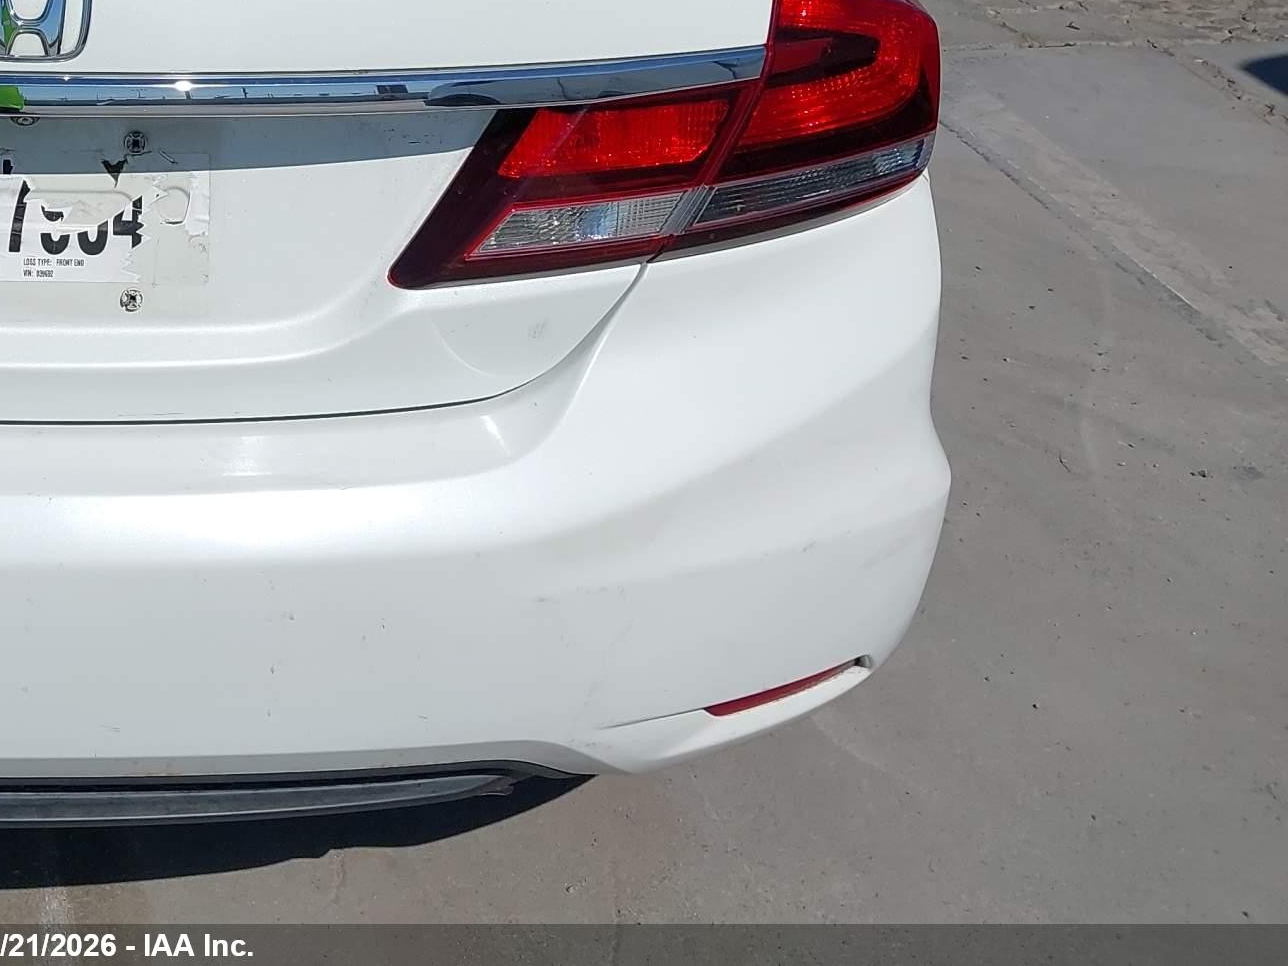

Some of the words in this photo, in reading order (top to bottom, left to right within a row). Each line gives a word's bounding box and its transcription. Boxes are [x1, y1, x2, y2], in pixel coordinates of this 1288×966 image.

[23, 257, 36, 266] LOSS
[37, 258, 52, 266] TYPE:
[56, 258, 73, 267] FRONT
[73, 258, 85, 267] END
